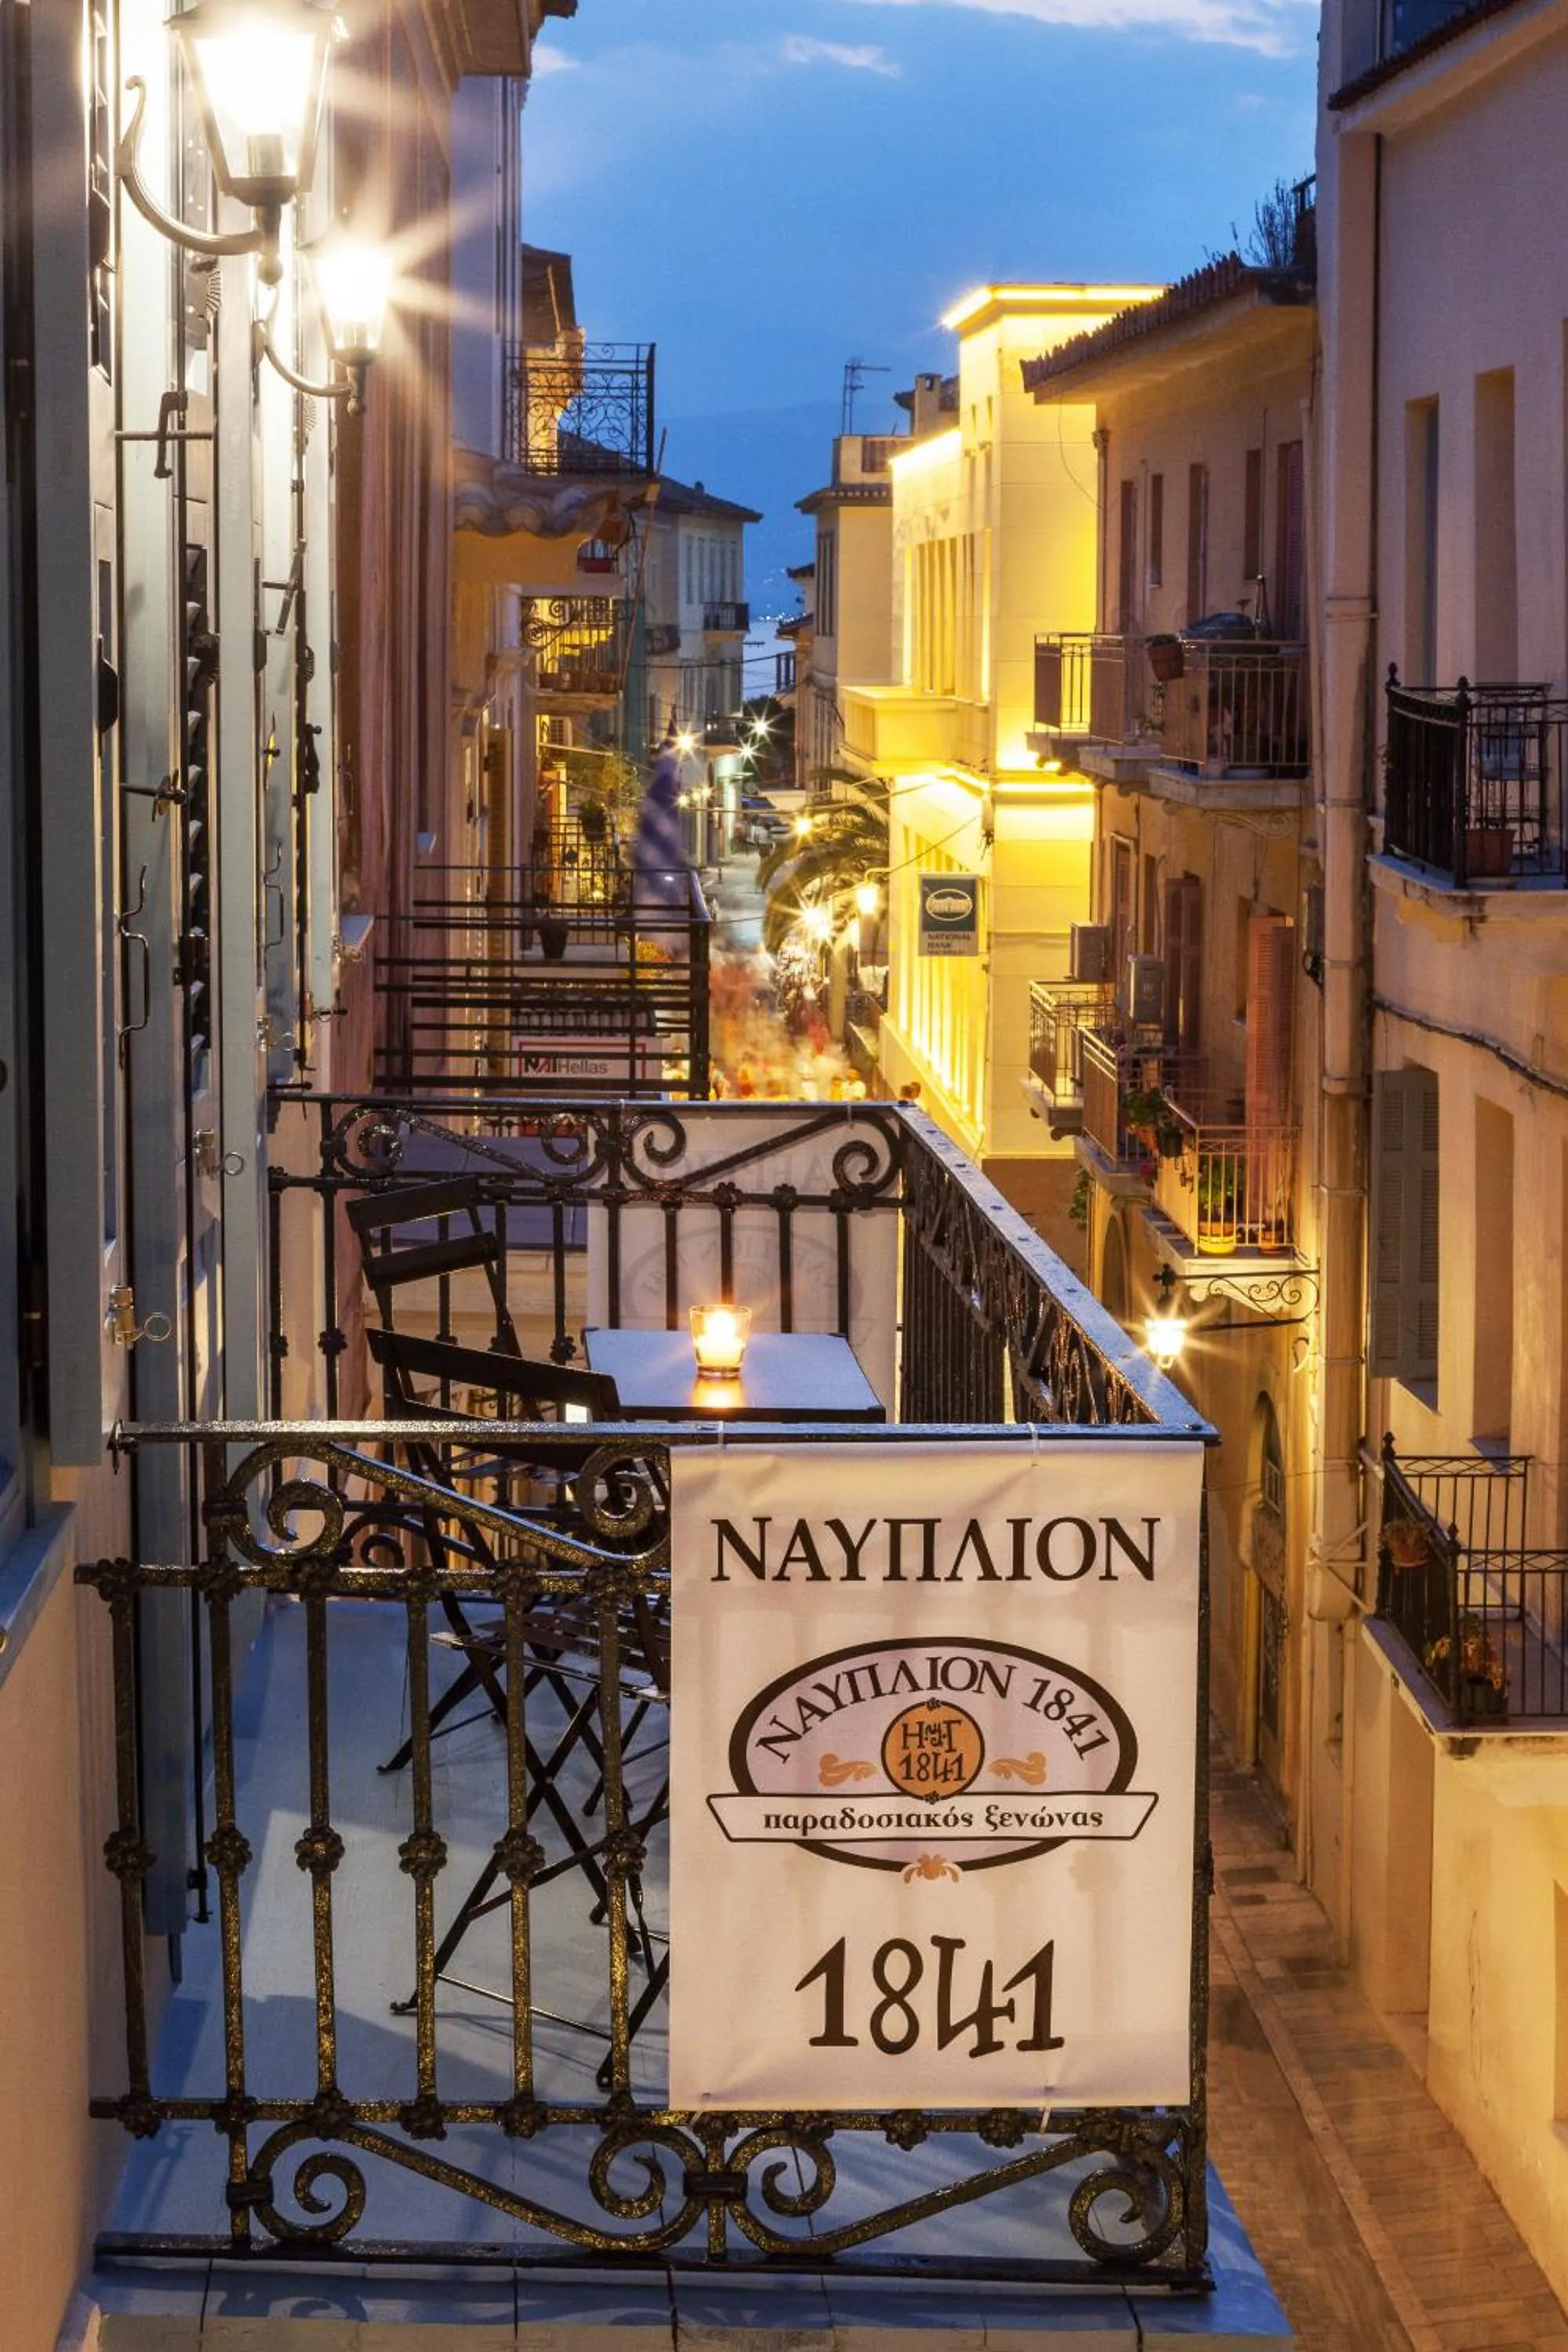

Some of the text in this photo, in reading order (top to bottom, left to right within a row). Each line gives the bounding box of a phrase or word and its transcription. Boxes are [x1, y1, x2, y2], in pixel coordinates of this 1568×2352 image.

[710, 1516, 1160, 1582] ΝΑΥΠΛΙΟΝ
[755, 1657, 1110, 1764] ΝΑΥΠΛΙΟΝ 1841
[898, 1751, 967, 1784] 1841
[764, 1805, 1103, 1837] παραδοσιακός ξενώνας
[795, 1935, 1065, 2059] 1841
